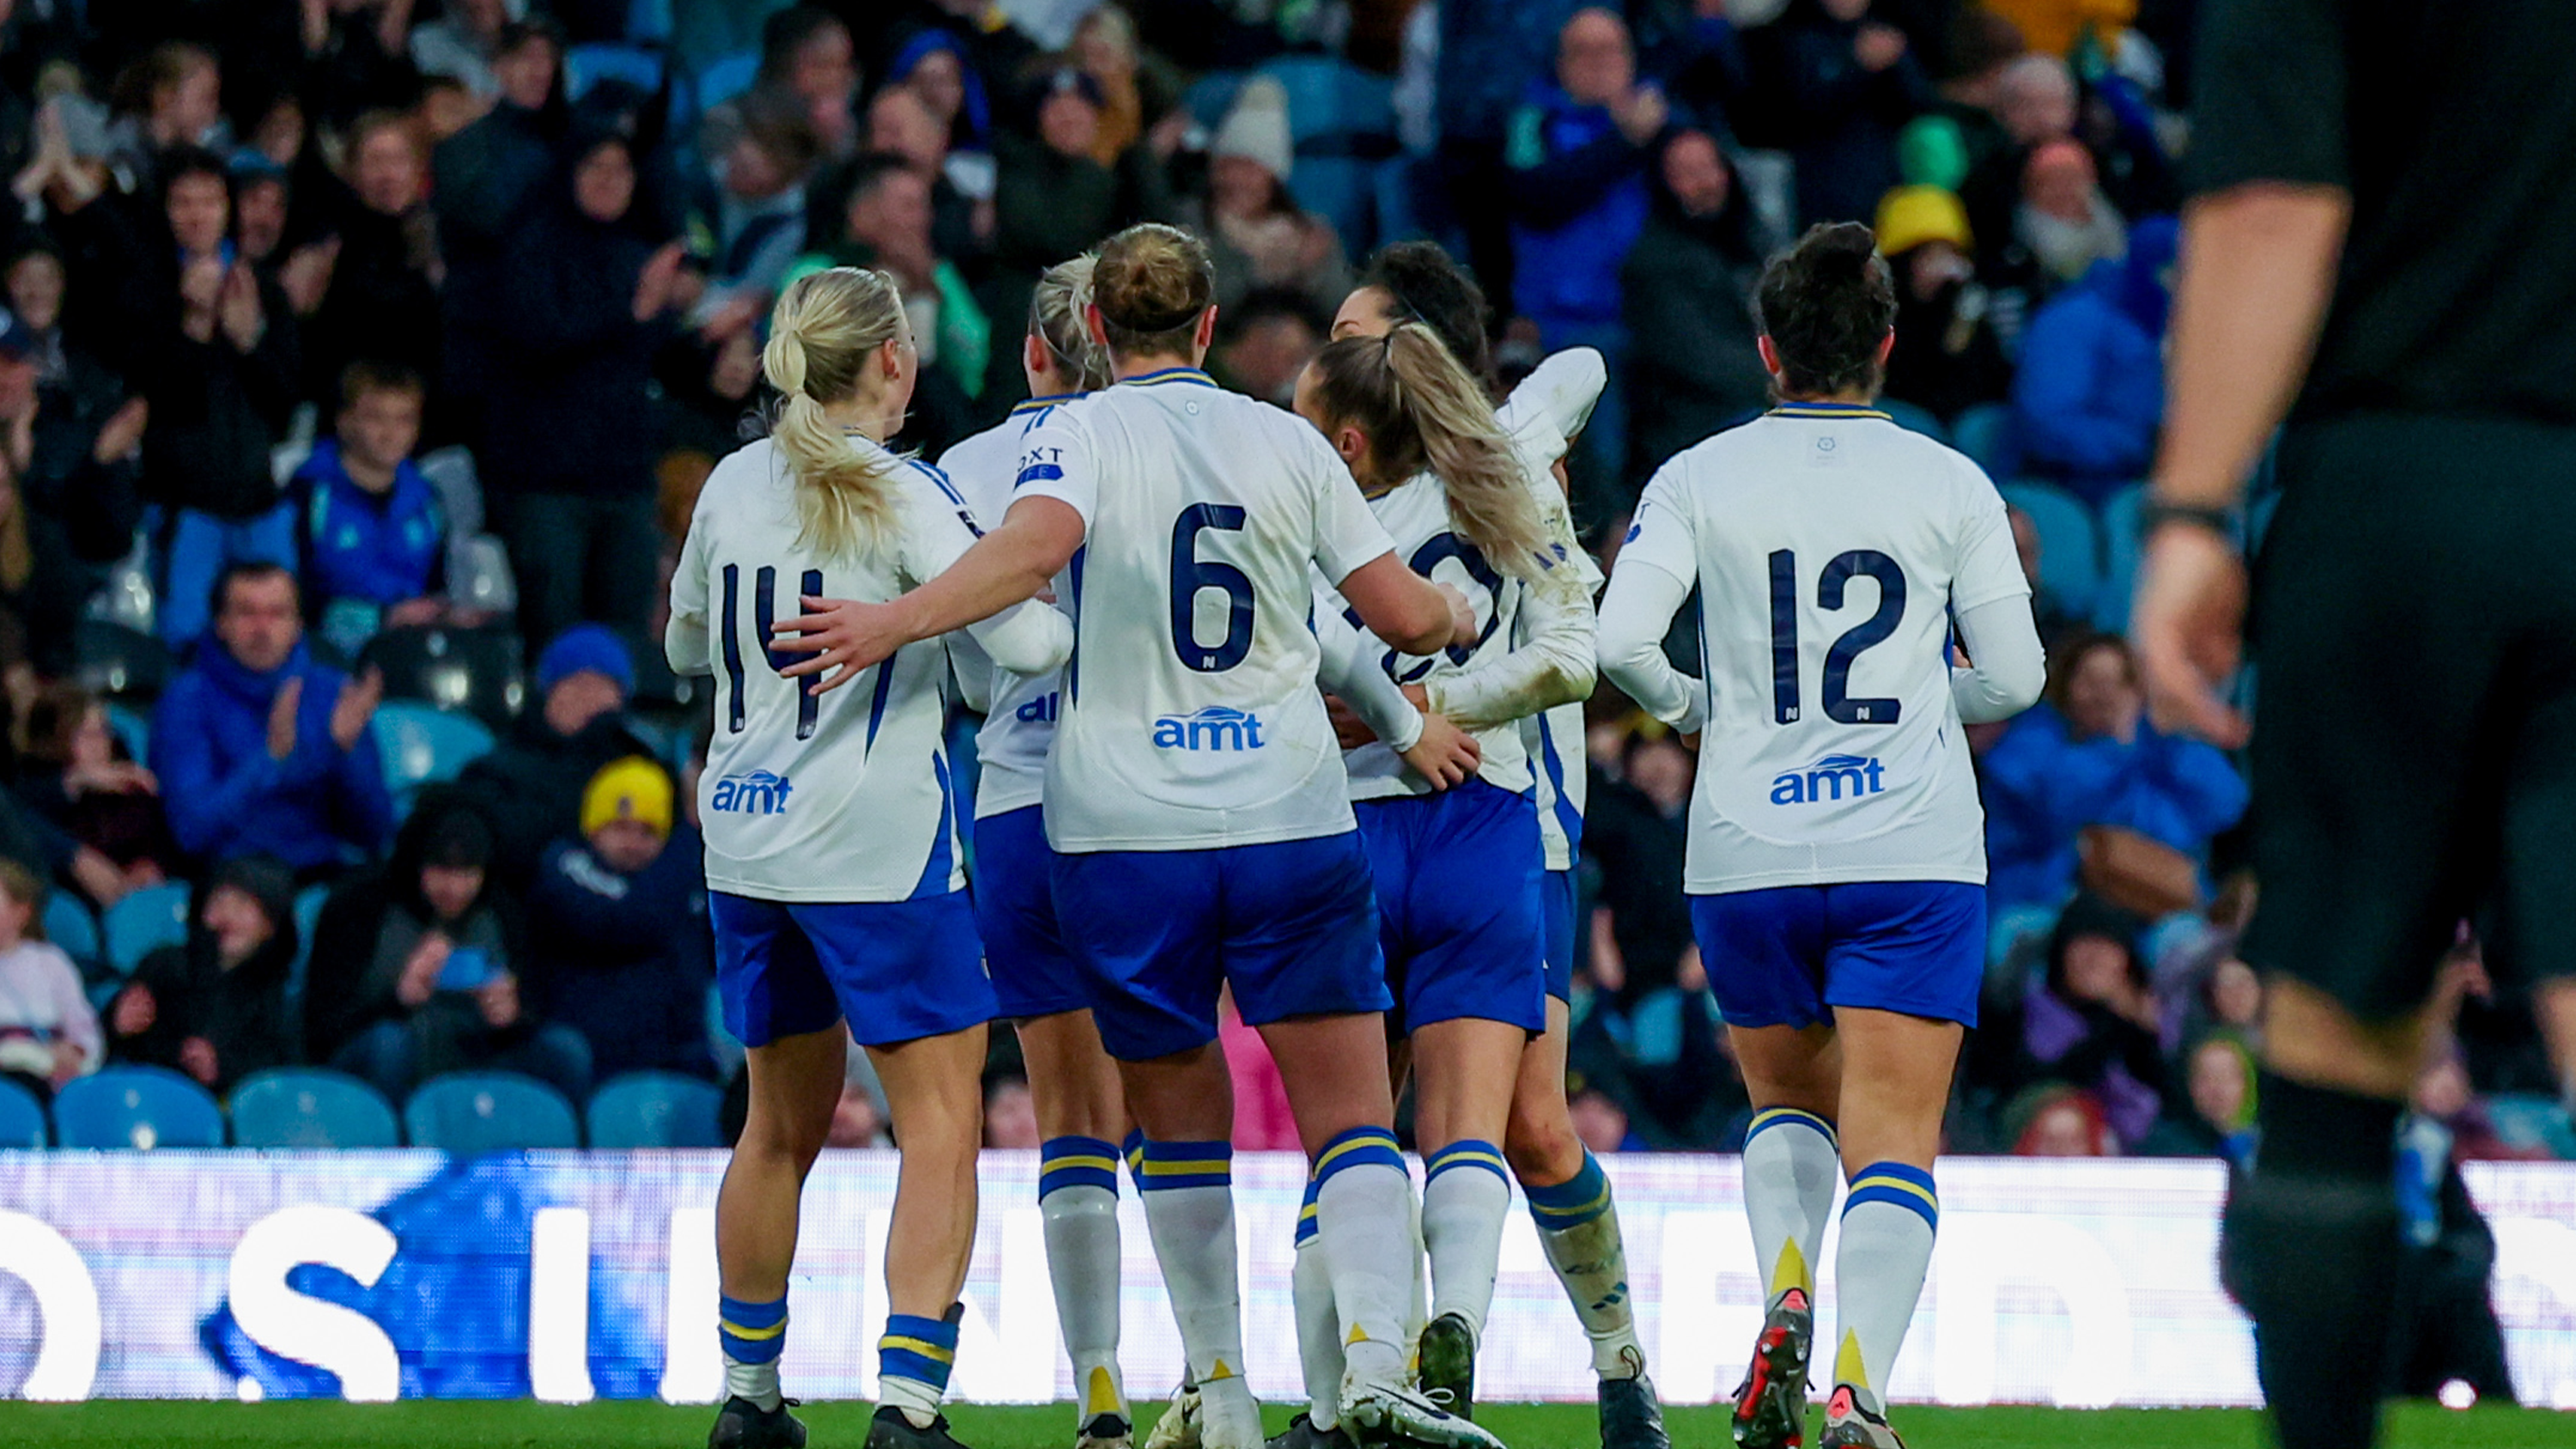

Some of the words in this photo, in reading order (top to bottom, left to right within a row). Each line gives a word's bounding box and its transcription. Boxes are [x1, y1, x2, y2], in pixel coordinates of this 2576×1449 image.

[1170, 502, 1255, 672] 6
[1768, 548, 1906, 725] 12
[721, 563, 823, 740] 14
[1152, 713, 1266, 751] amt
[1770, 757, 1886, 806] amt
[712, 776, 793, 815] amt
